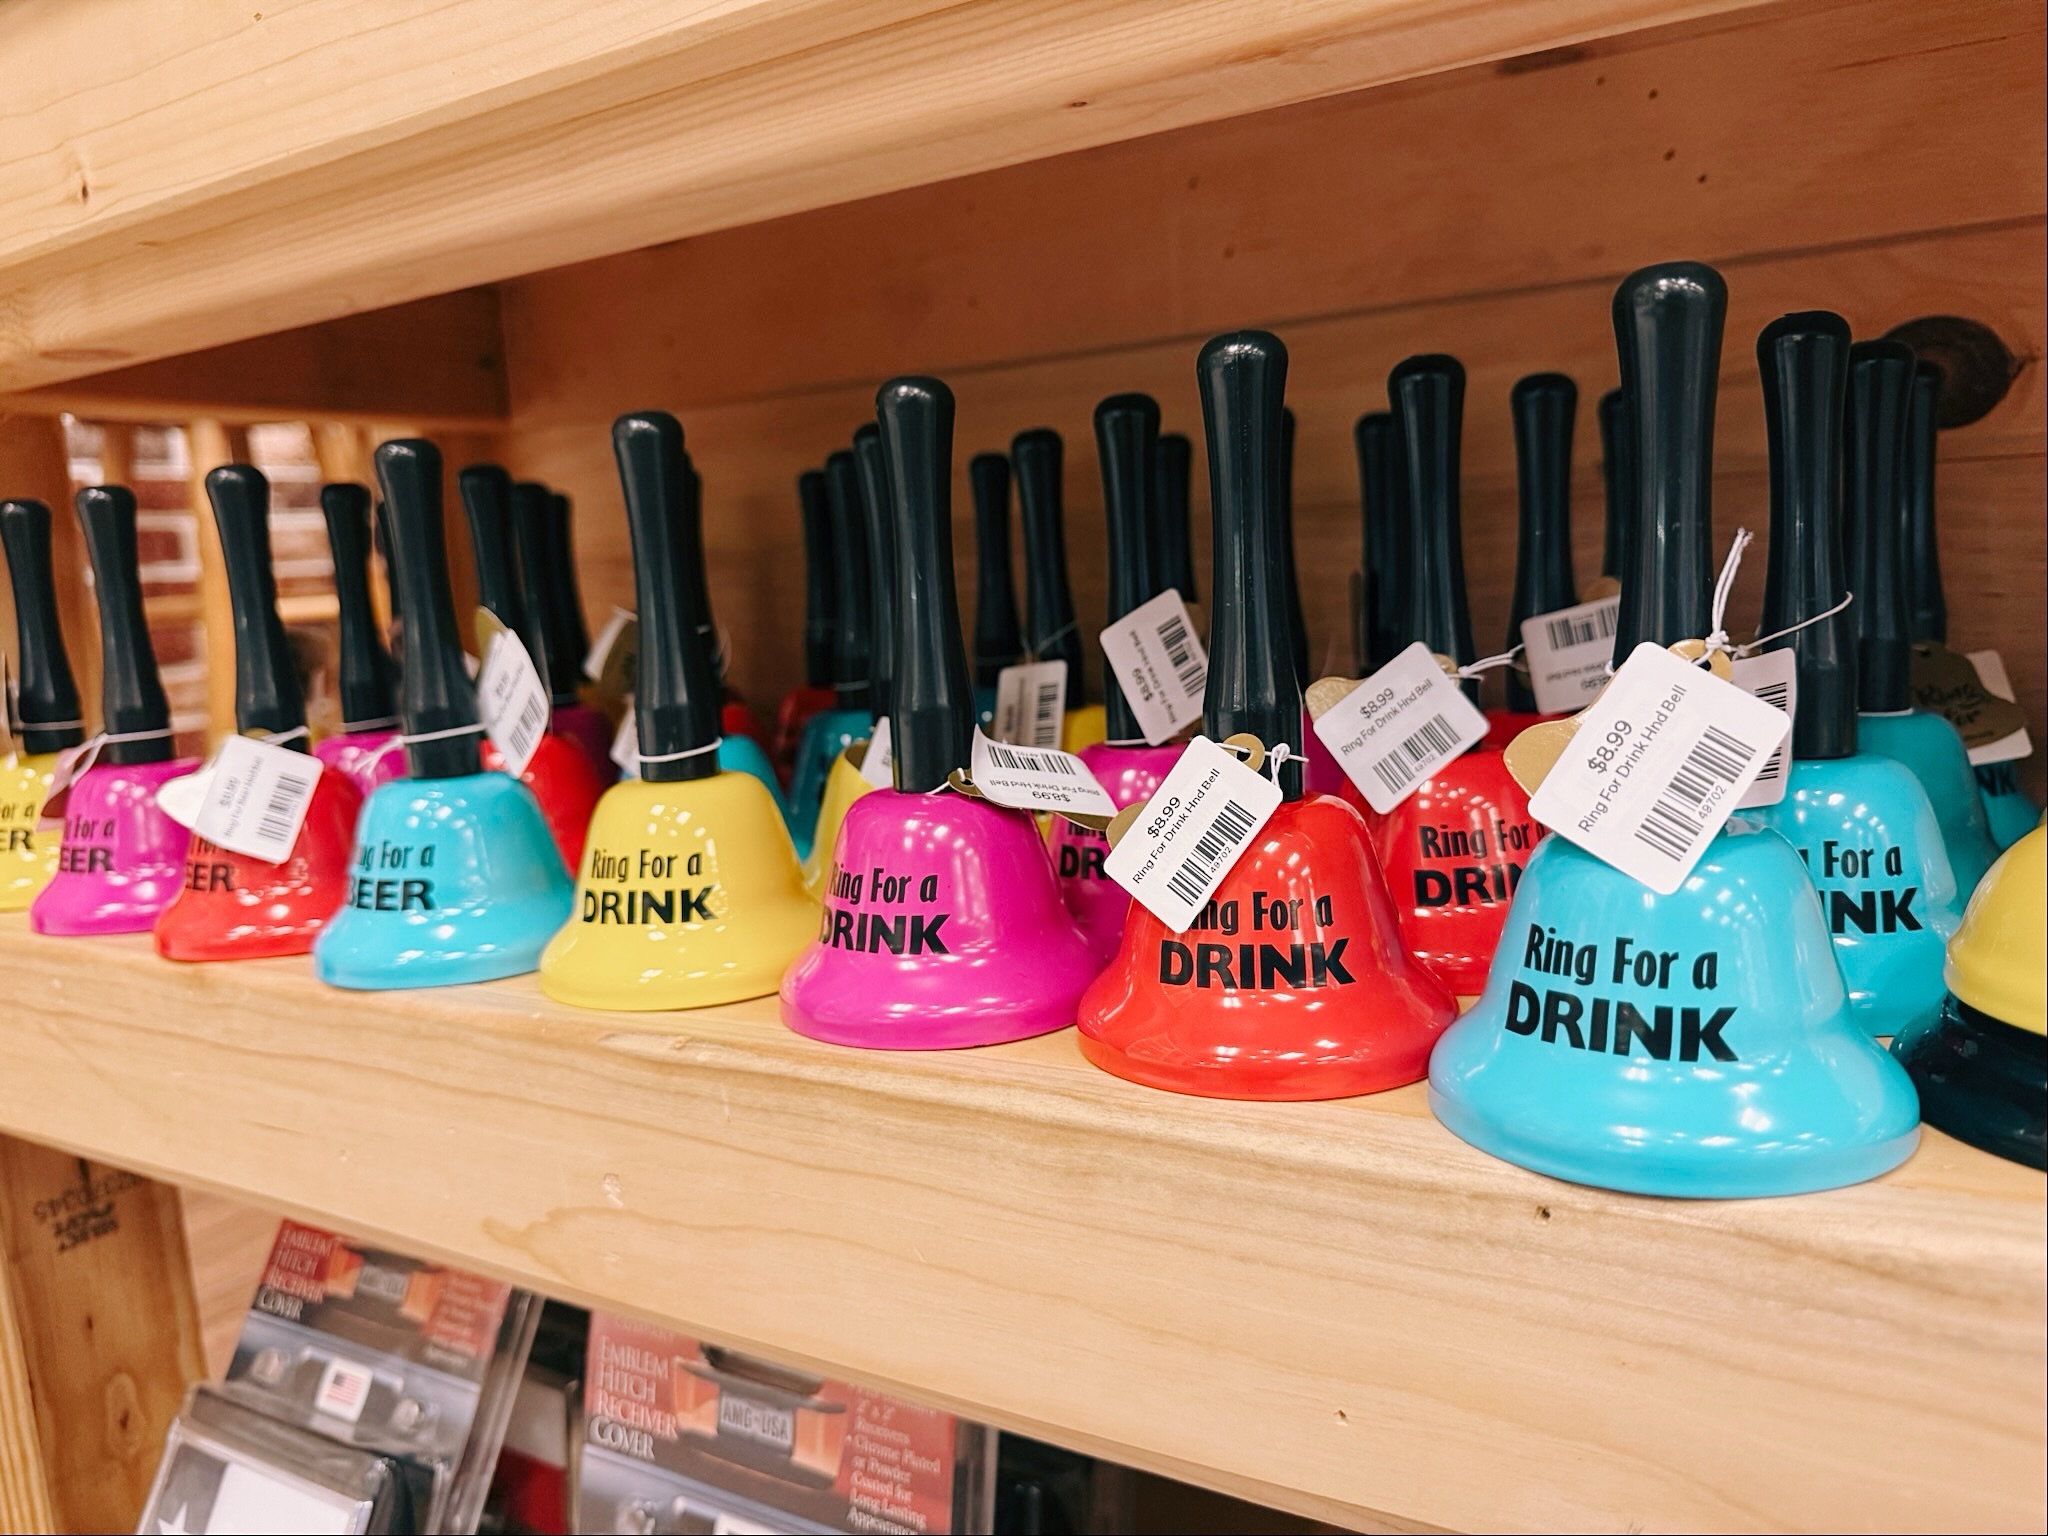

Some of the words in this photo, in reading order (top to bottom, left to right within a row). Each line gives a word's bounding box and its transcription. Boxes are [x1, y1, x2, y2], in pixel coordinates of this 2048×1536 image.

[1340, 736, 1364, 756] Ring
[1361, 723, 1377, 741] For
[1376, 706, 1400, 728] Drink
[1399, 691, 1418, 711] Hnd
[1415, 679, 1434, 696] Bell
[1360, 687, 1395, 719] $8.99
[1578, 800, 1609, 832] Ring
[1599, 778, 1623, 802] For
[1615, 740, 1649, 778] Drink
[1640, 710, 1669, 742] Hnd
[1660, 684, 1688, 713] Bell
[1587, 719, 1633, 774] $8.99
[989, 779, 1009, 787] Bell
[1011, 781, 1033, 790] Hnd
[1032, 791, 1071, 802] $8.99
[1034, 783, 1060, 792] Drink
[1062, 785, 1078, 794] For
[1078, 787, 1101, 796] Ring
[1698, 785, 1727, 819] 49702
[0, 804, 15, 819] or
[1132, 859, 1154, 884] Ring
[1151, 842, 1167, 861] For
[1163, 813, 1190, 842] Drink
[1185, 789, 1205, 813] Hnd
[1201, 768, 1220, 791] Bell
[1147, 796, 1181, 839] $8.99
[380, 840, 414, 869] For
[420, 844, 436, 867] a
[1420, 823, 1488, 859] Ring
[1495, 818, 1530, 852] For
[1823, 840, 1875, 878] For
[1884, 846, 1903, 877] a
[60, 848, 116, 873] EER
[591, 848, 630, 883] Ring
[639, 848, 678, 878] For
[687, 851, 702, 876] a
[1210, 846, 1232, 873] 49702
[829, 860, 864, 905] Ring
[870, 867, 912, 903] For
[919, 874, 939, 902] a
[583, 884, 718, 924] DRINK
[1190, 898, 1239, 936] ng
[1252, 891, 1304, 931] For
[1315, 895, 1334, 928] a
[819, 904, 951, 955] DRINK
[1159, 937, 1357, 990] DRINK
[1523, 922, 1598, 986] Ring
[1612, 936, 1680, 990] For
[1692, 951, 1718, 991] a
[1504, 979, 1740, 1063] DRINK
[601, 1336, 670, 1380] EMBLEM
[600, 1363, 657, 1405] HITCH
[597, 1389, 679, 1441] RECEIVER
[589, 1415, 655, 1461] COVER
